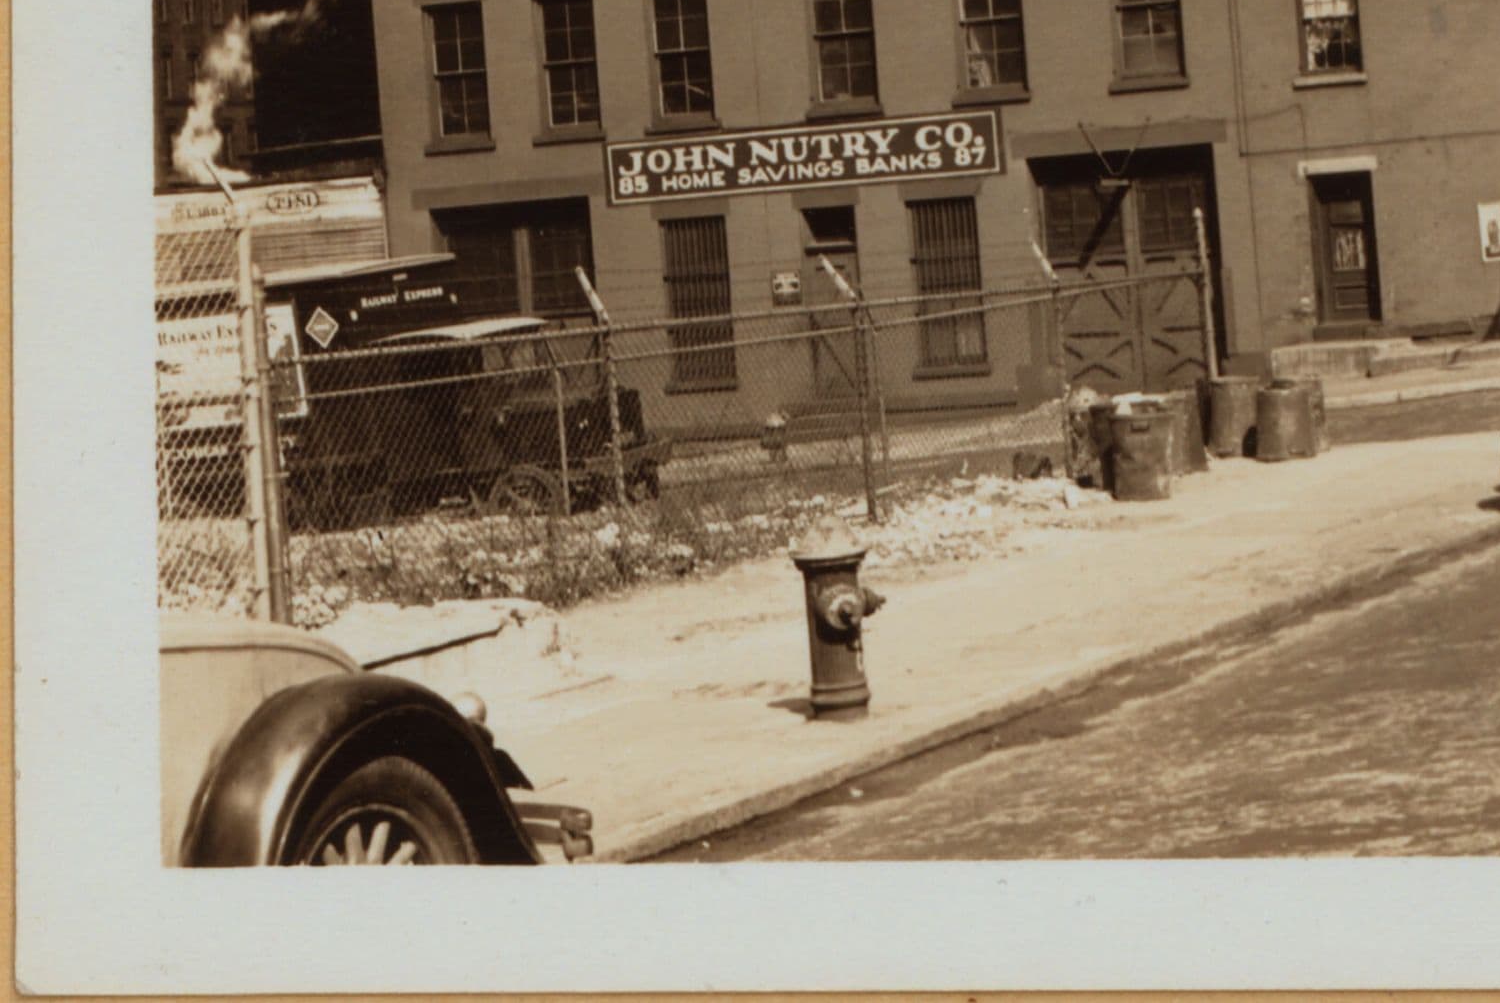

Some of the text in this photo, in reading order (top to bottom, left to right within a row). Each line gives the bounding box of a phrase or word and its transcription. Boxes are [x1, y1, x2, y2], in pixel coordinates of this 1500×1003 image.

[618, 121, 985, 178] JOHN NUTRY CO.
[618, 145, 986, 196] 85 HOME SAVINGS BANKS 87
